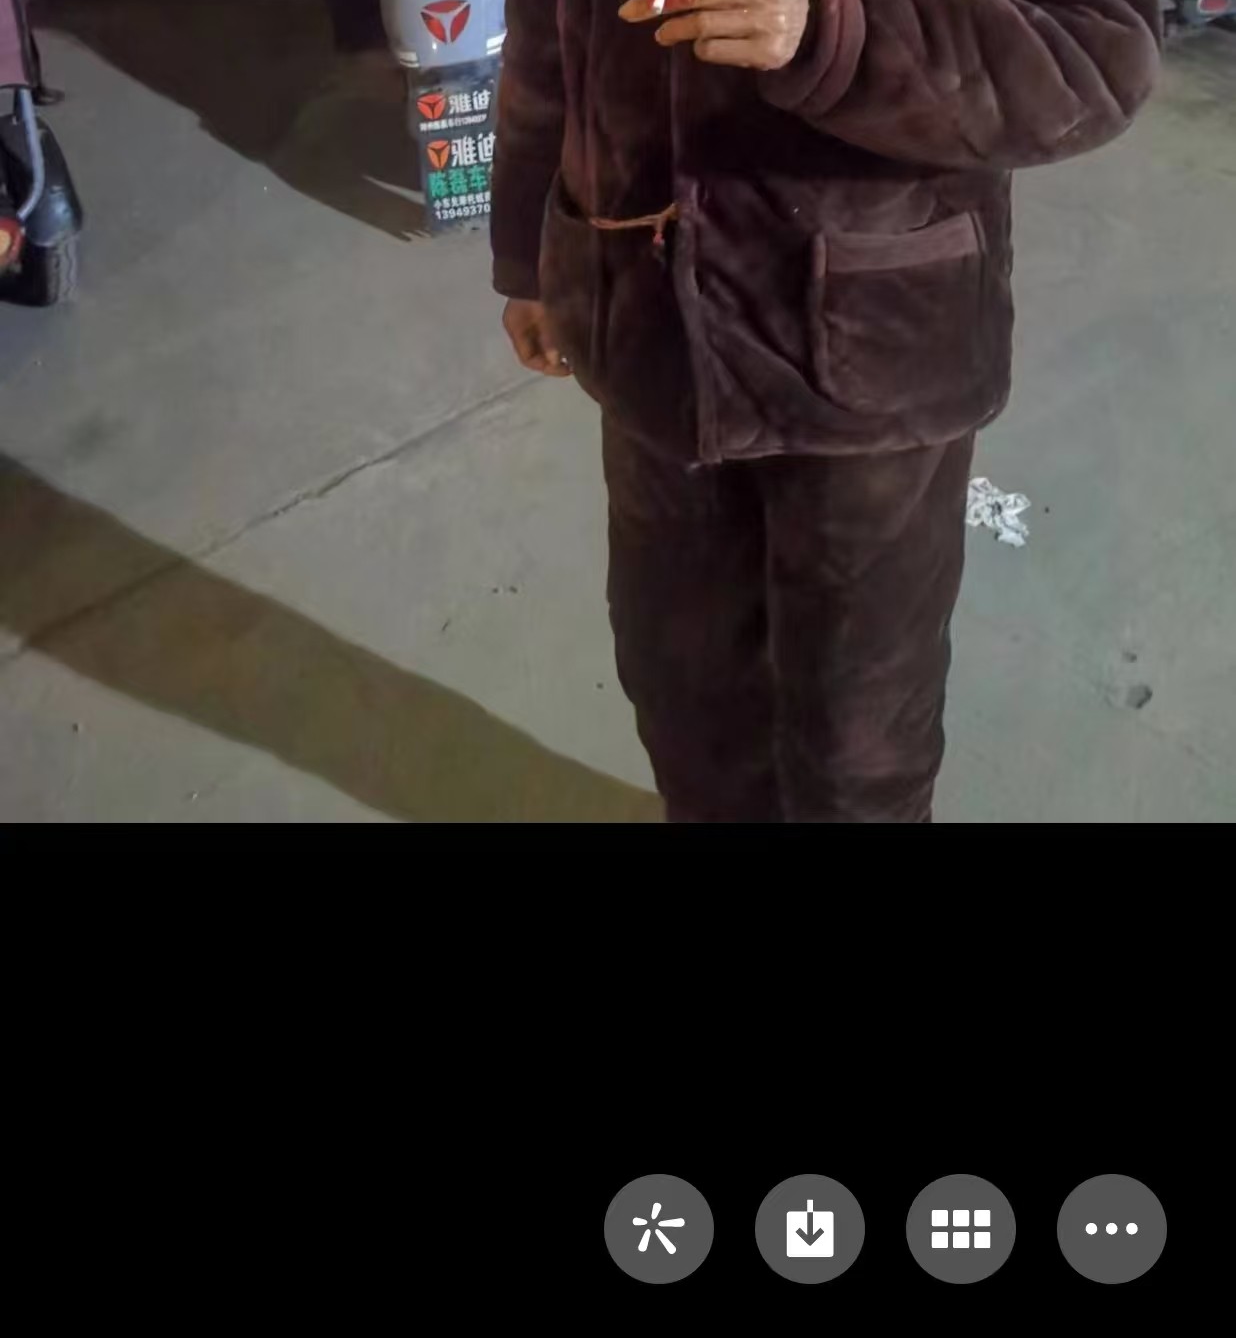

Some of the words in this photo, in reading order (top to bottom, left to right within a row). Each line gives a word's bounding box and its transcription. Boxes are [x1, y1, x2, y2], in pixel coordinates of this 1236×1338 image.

[448, 89, 491, 114] 雅迪
[451, 131, 496, 167] 雅迪
[428, 163, 493, 197] 陈磊车
